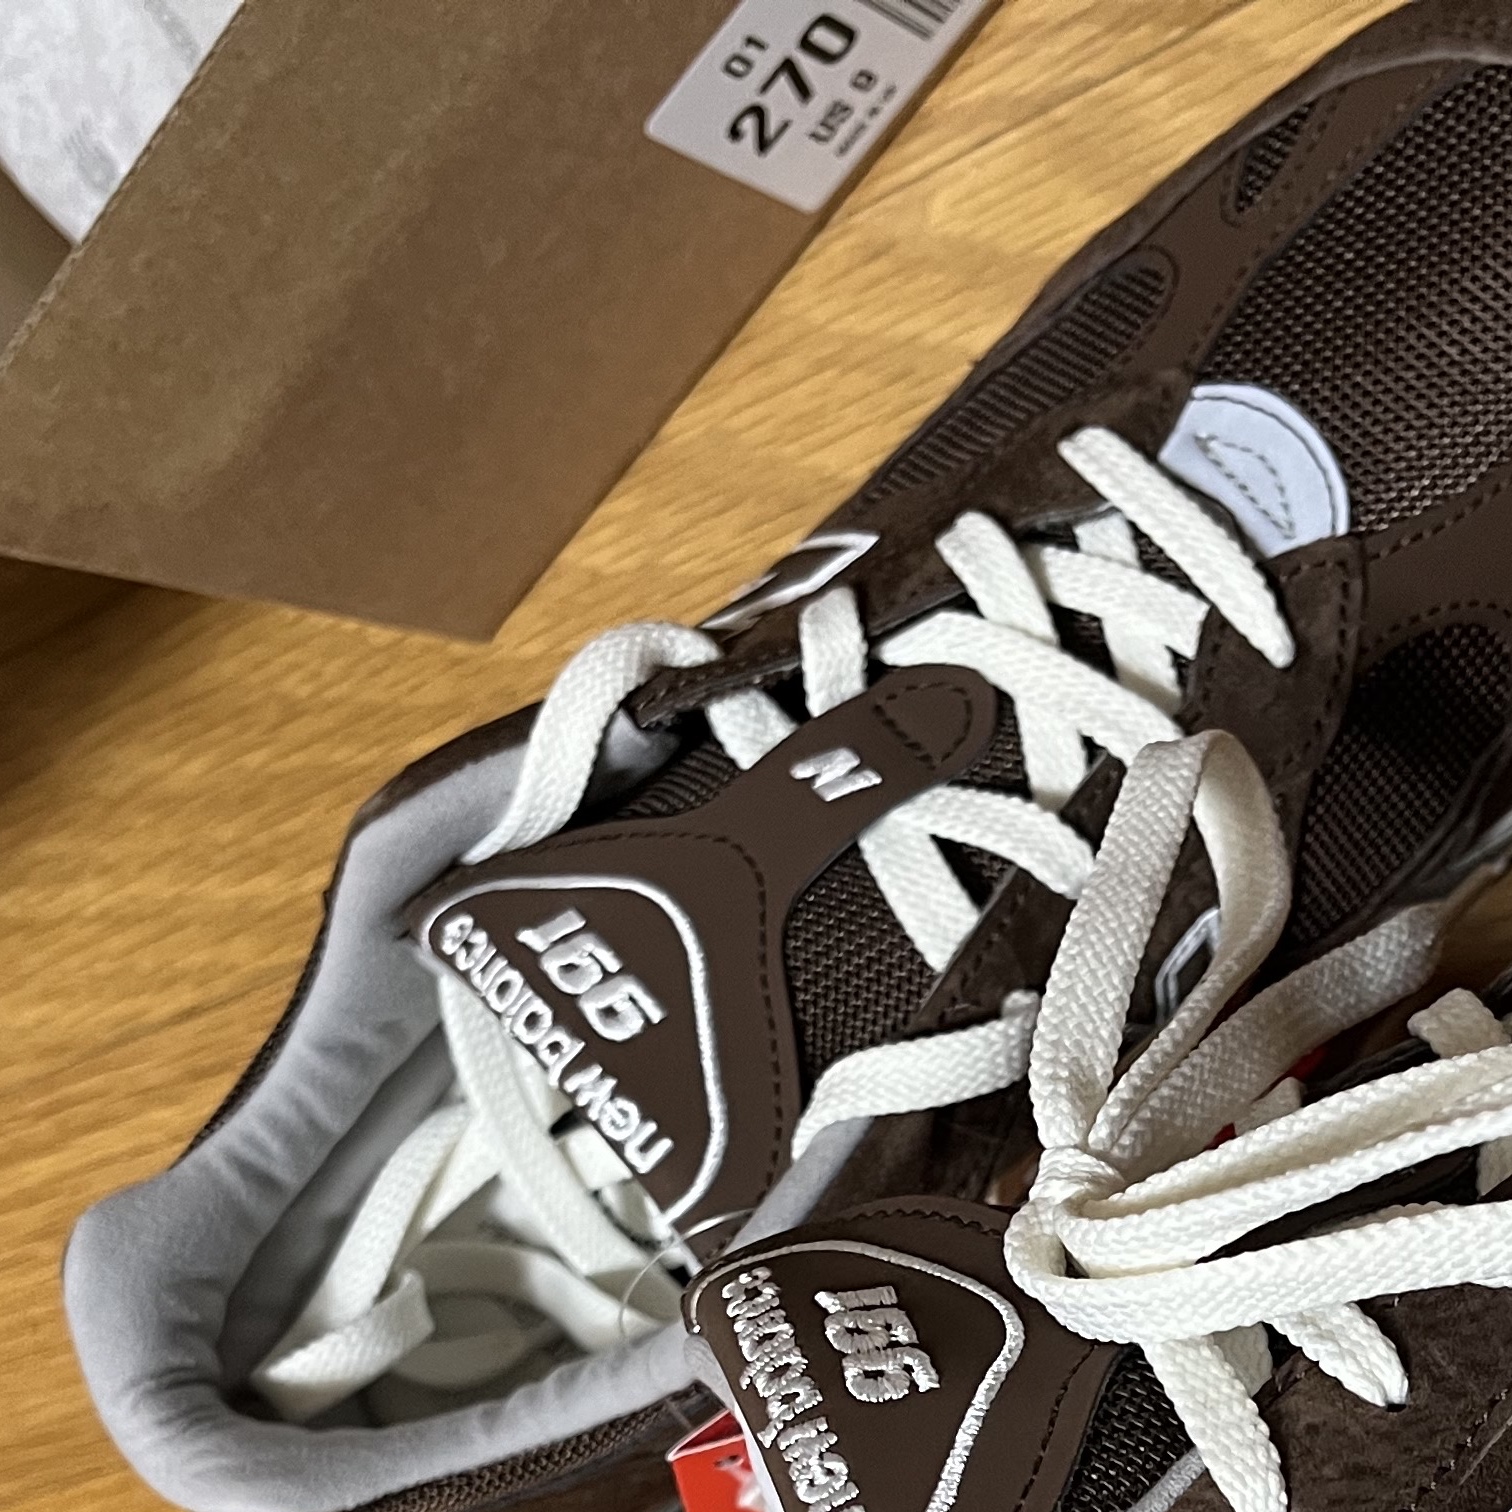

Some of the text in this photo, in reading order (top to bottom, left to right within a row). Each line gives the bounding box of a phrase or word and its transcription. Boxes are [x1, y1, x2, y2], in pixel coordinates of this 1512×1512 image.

[722, 34, 769, 79] 01
[727, 12, 858, 156] 270
[808, 100, 854, 144] US
[789, 746, 883, 801] N
[515, 905, 669, 1043] 991
[441, 913, 674, 1174] new balance
[722, 1266, 824, 1449] balance
[814, 1285, 941, 1403] 991
